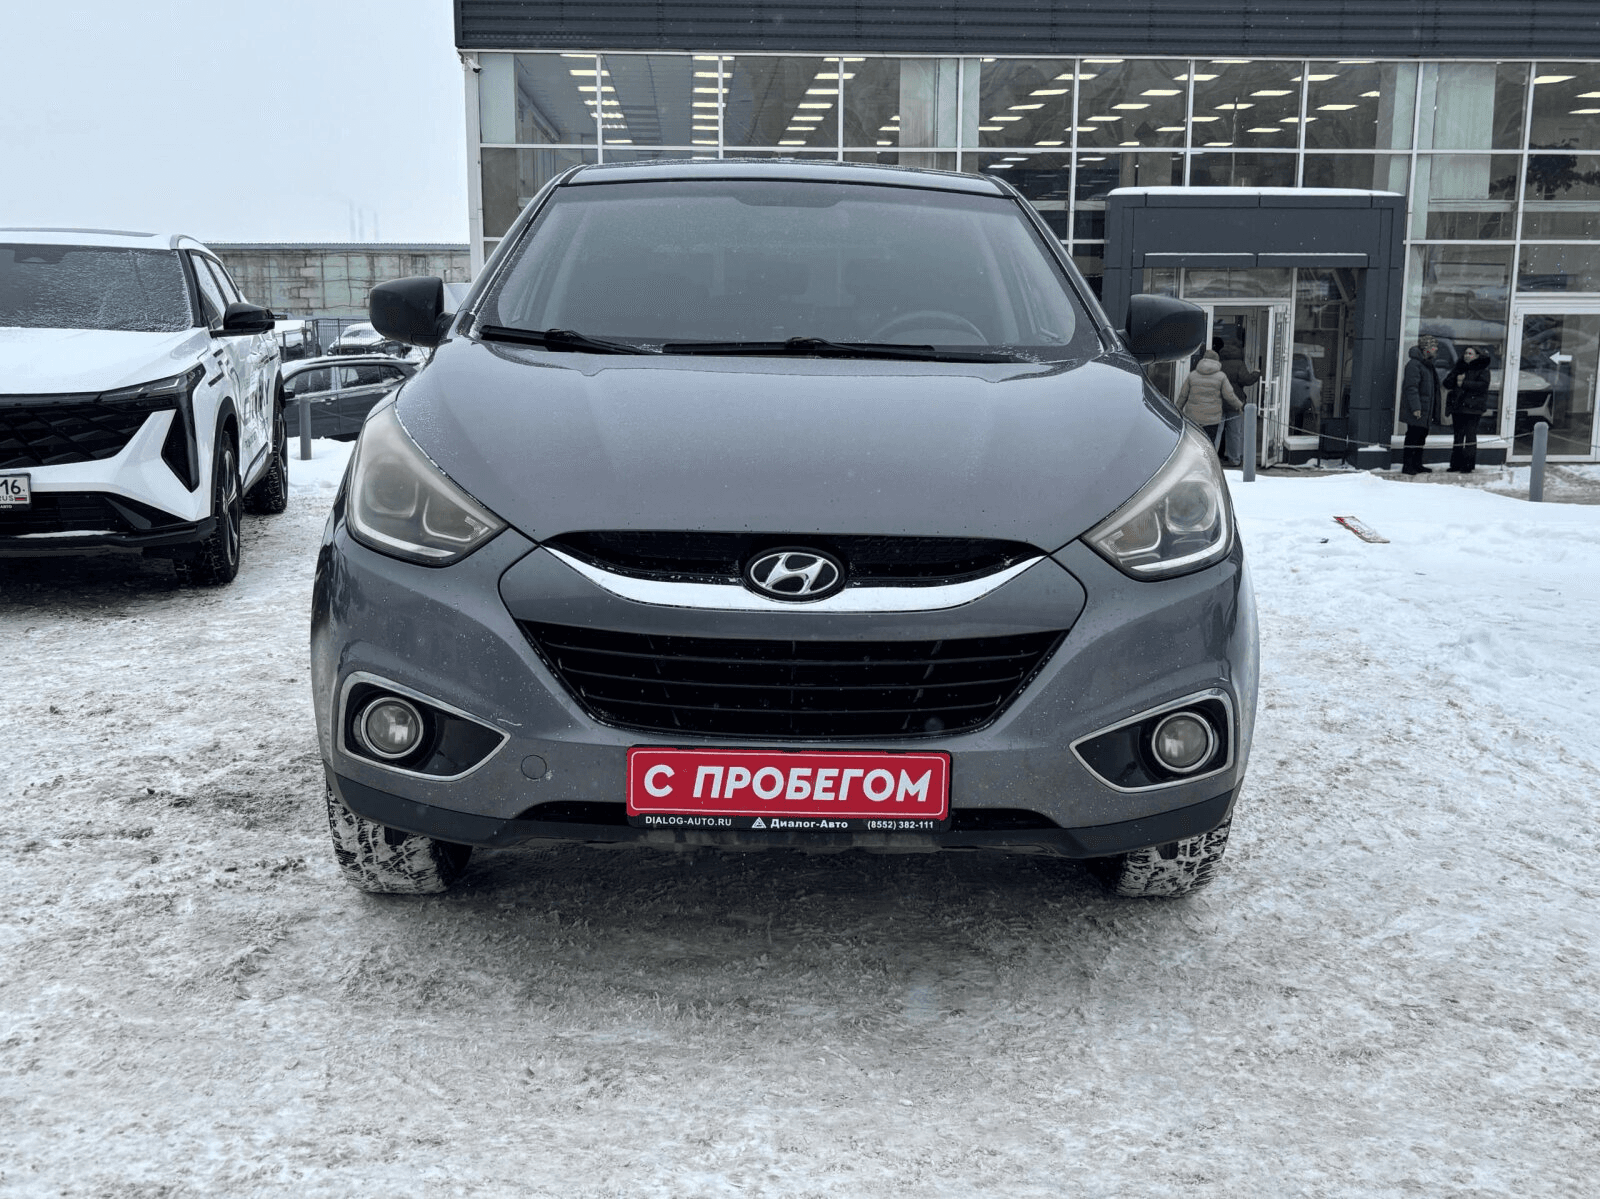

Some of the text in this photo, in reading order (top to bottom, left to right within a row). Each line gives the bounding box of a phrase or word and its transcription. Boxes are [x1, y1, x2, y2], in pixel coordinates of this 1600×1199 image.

[644, 764, 932, 802] С ПРОБЕГОМ
[645, 816, 732, 827] DIALOG-AUTO.RU
[770, 818, 849, 830] Диалог-Авто
[867, 820, 934, 831] (8552) 382-111
